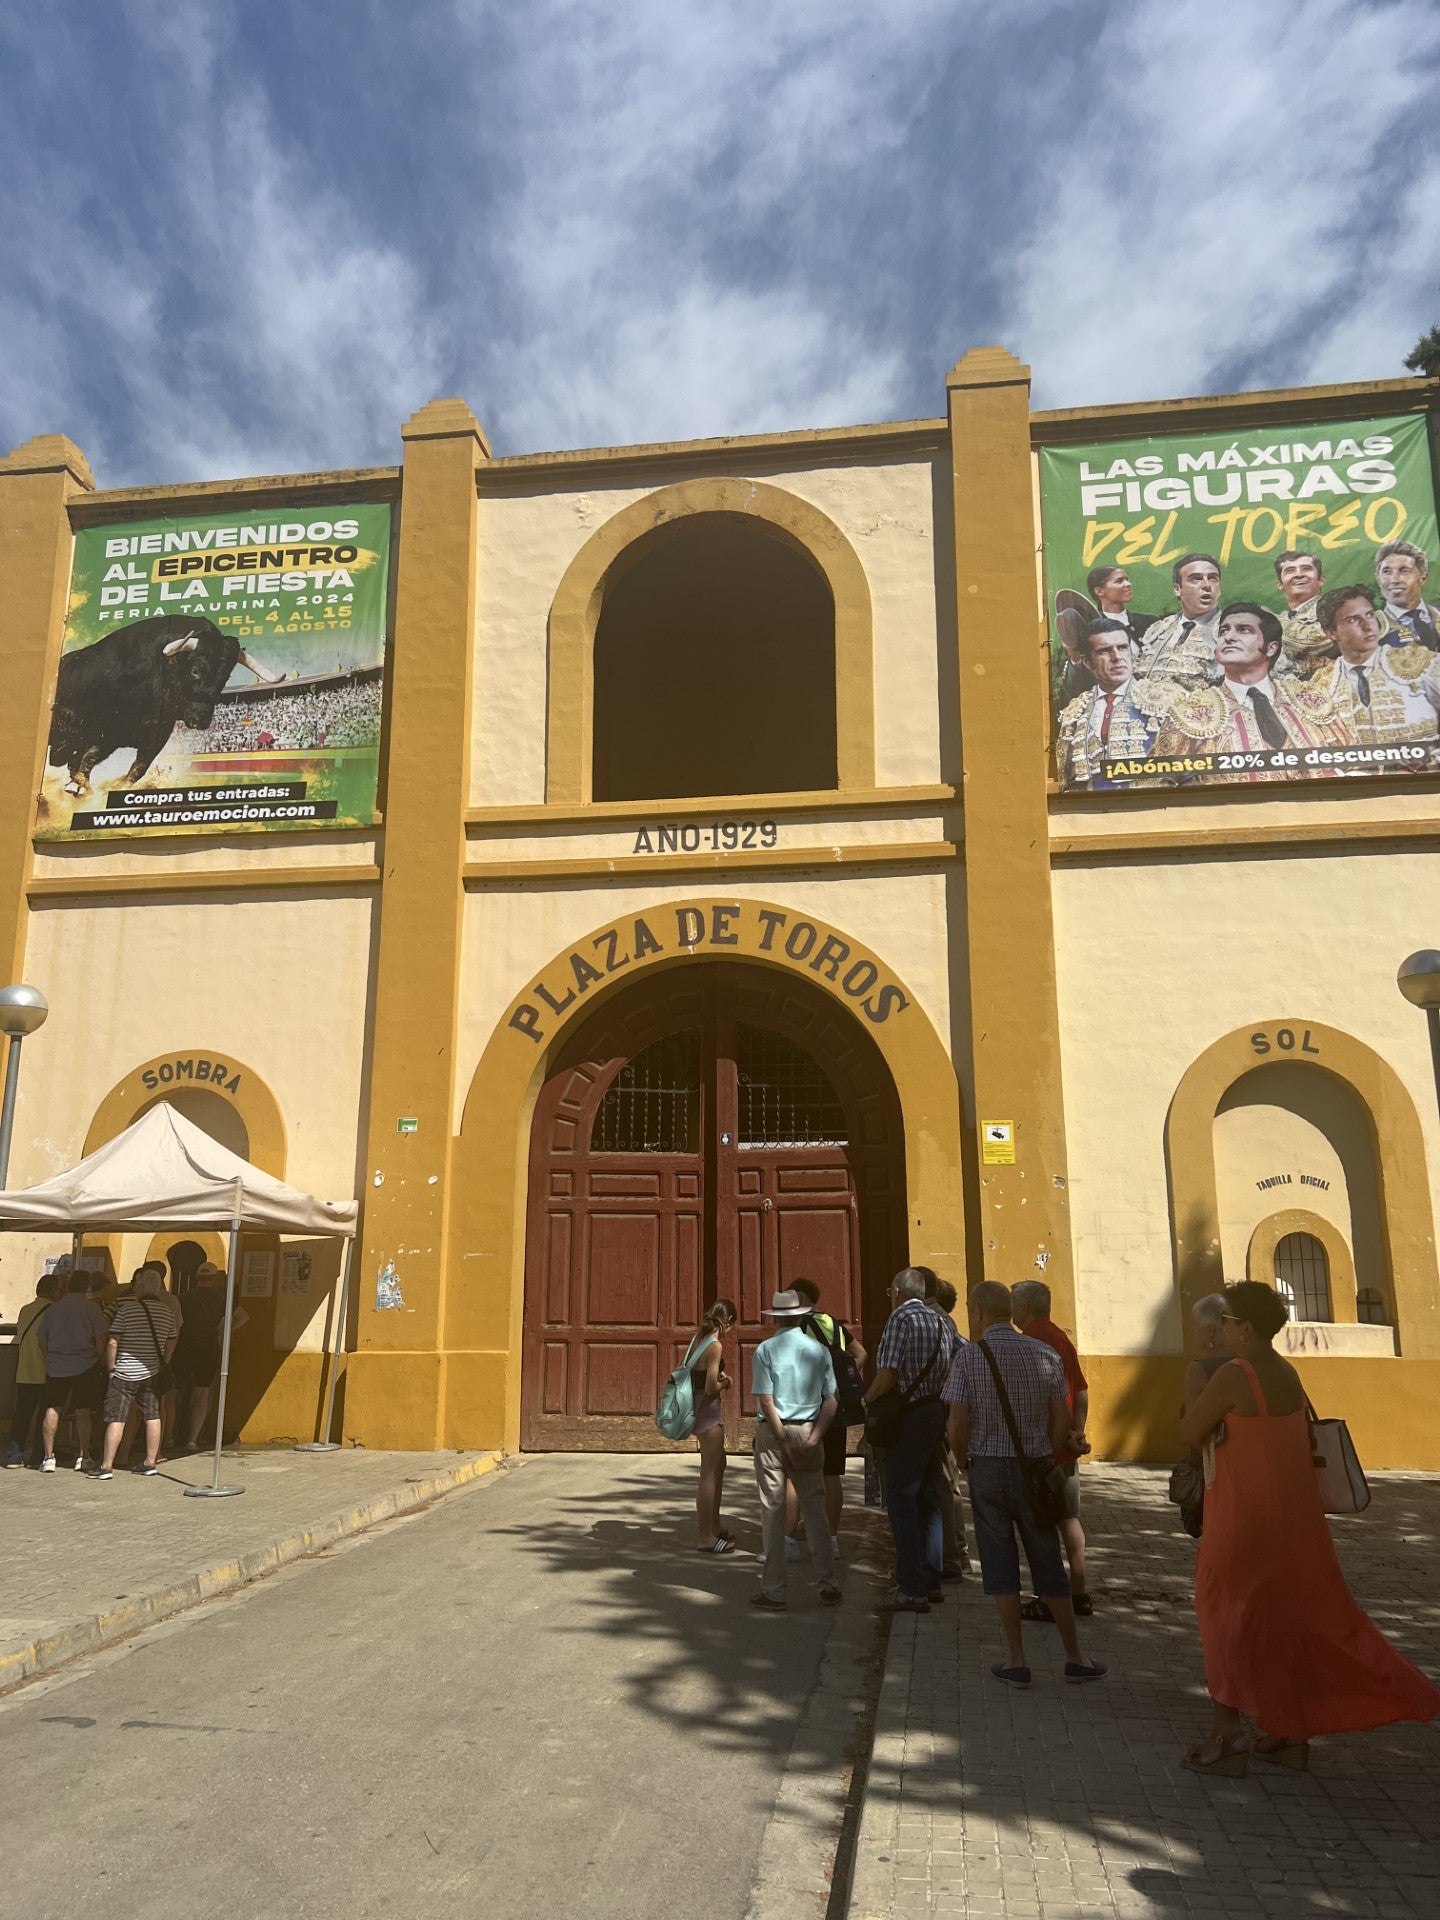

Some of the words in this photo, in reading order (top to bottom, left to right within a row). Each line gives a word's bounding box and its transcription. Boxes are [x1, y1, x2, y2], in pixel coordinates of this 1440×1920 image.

[1079, 455, 1164, 482] LAS
[1178, 435, 1394, 473] MÁXIMAS
[1081, 459, 1397, 516] FIGURAS
[105, 519, 359, 558] BIENVENIDOS
[1081, 510, 1189, 567] DEL
[1207, 497, 1408, 567] TOREO
[103, 562, 147, 582] AL
[158, 545, 358, 577] EPICENTRO
[100, 584, 149, 606] DE
[160, 579, 210, 601] LA
[222, 569, 355, 596] FIESTA
[98, 606, 166, 621] FERIA
[180, 598, 281, 614] TAURINA
[296, 593, 354, 606] 2024
[218, 614, 256, 626] DEL
[265, 610, 279, 622] 4
[289, 611, 314, 621] AL
[323, 605, 353, 619] 15
[238, 626, 264, 636] DE
[273, 619, 352, 633] AGOSTO
[1106, 757, 1213, 779] ¡Abónate!
[1217, 754, 1265, 770] 20%
[1270, 751, 1299, 767] de
[1304, 746, 1426, 765] descuento
[124, 791, 183, 806] Compra
[188, 790, 212, 802] tus
[215, 786, 290, 800] entradas:
[92, 804, 316, 826] www.tauroemocion.com
[508, 918, 663, 1045] PLAZA
[675, 905, 740, 948] DE
[758, 909, 910, 1024] TOROS
[1251, 1029, 1320, 1054] SOL
[142, 1060, 241, 1094] SOMBRA
[1256, 1174, 1292, 1191] TAQUILLA
[1300, 1174, 1330, 1191] OFICIAL
